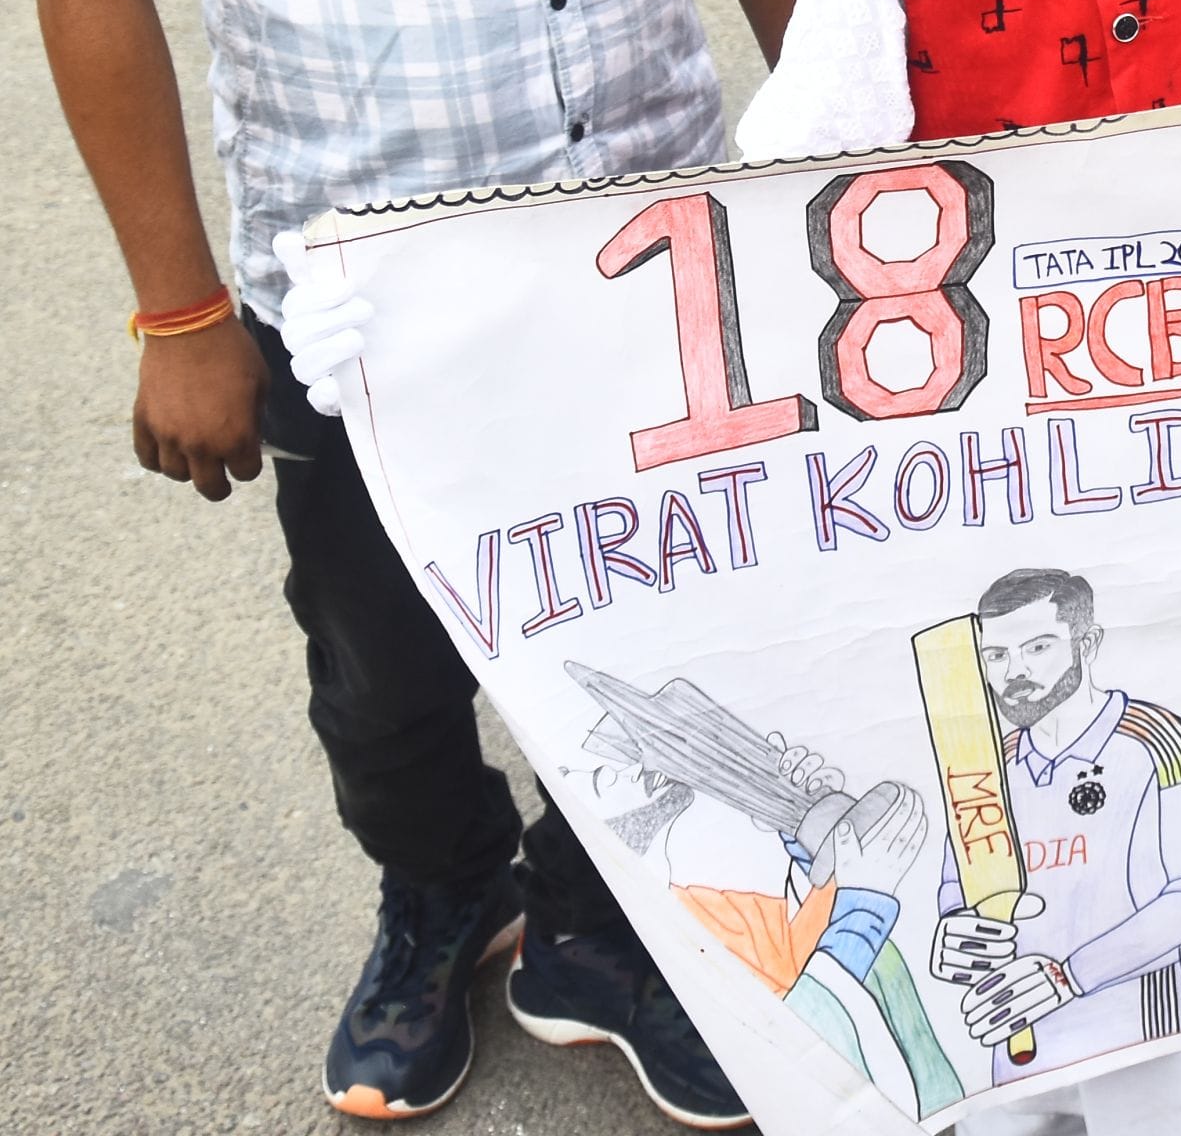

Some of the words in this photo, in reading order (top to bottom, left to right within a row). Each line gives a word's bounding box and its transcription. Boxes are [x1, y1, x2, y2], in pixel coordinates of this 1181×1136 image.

[596, 160, 995, 472] 18
[1023, 249, 1094, 279] TATA
[1101, 241, 1156, 271] IPL
[426, 461, 768, 660] VIRAT
[1024, 834, 1087, 872] DIA
